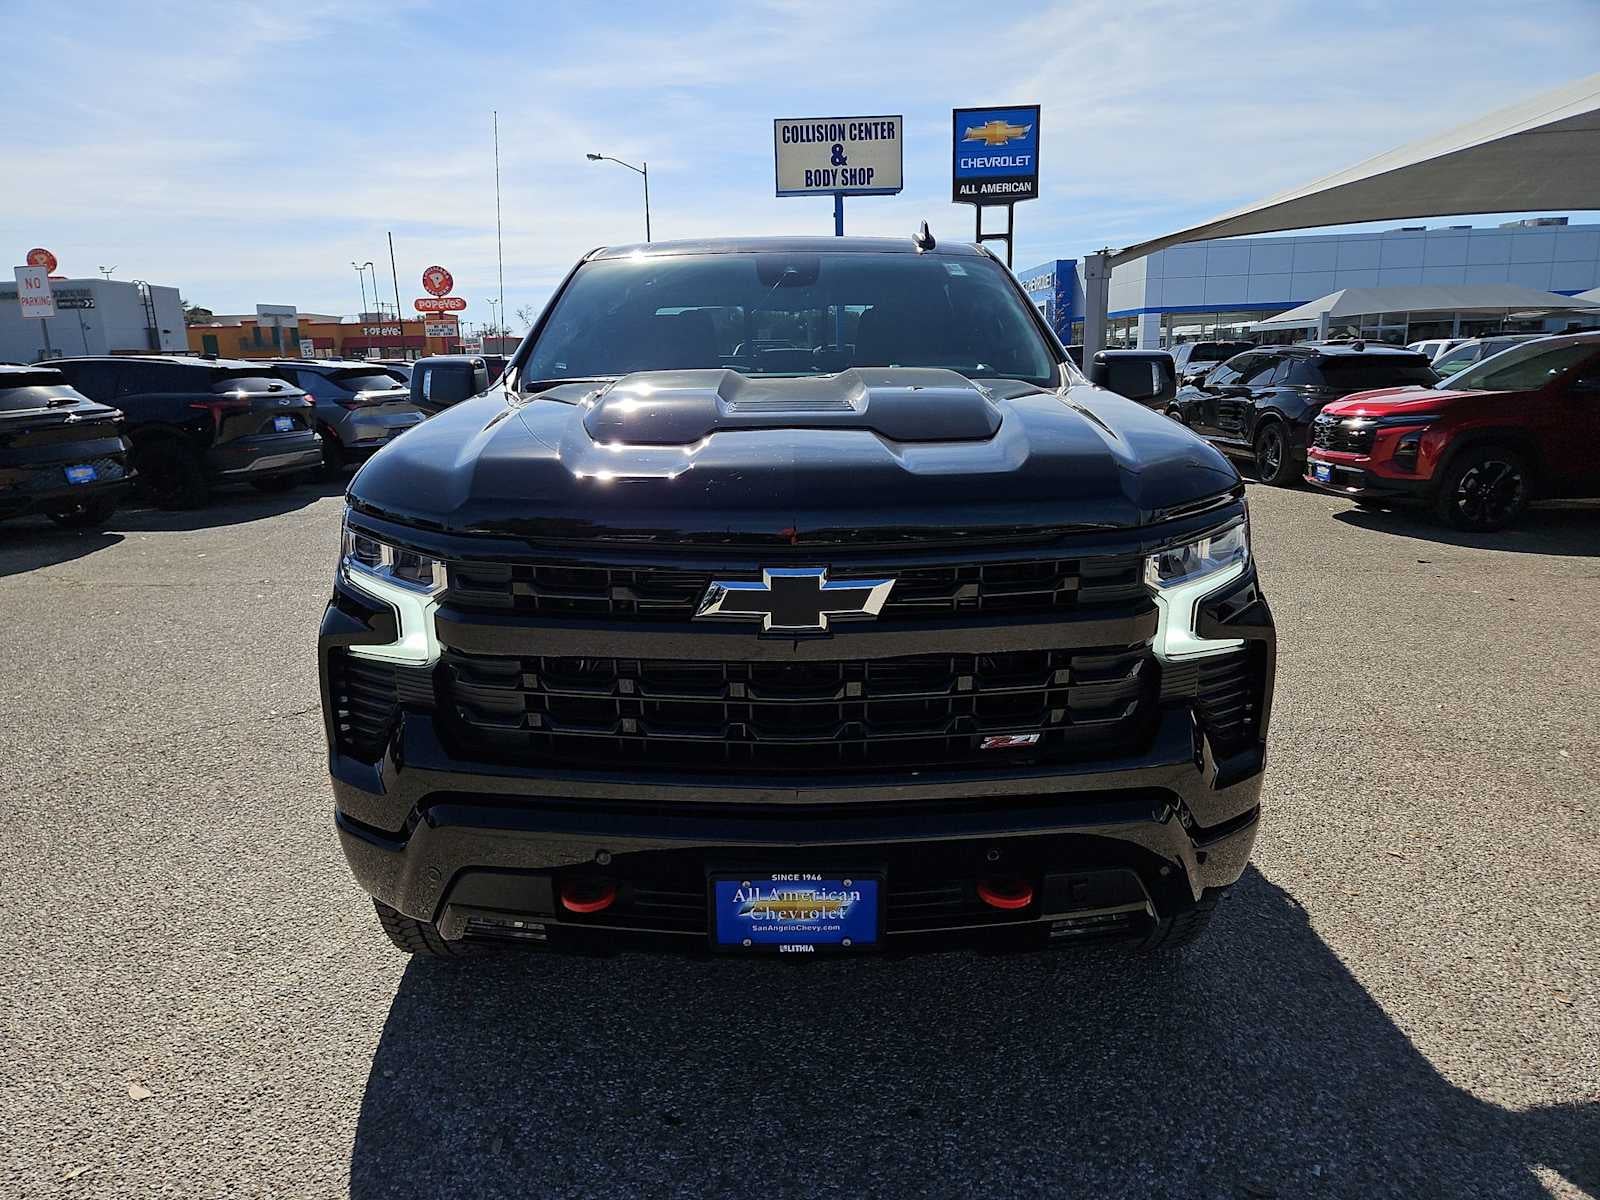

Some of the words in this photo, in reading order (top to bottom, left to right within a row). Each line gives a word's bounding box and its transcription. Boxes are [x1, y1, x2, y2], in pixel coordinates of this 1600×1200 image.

[782, 123, 846, 144] COLLISION
[849, 121, 895, 141] CENTER
[830, 143, 848, 166] &
[960, 155, 1031, 169] CHEVROLET
[805, 169, 838, 187] BODY
[840, 167, 874, 186] SHOP
[960, 184, 978, 194] ALL
[980, 182, 1032, 194] AMERICAN
[25, 277, 41, 289] NO
[21, 295, 51, 307] PARKING
[732, 887, 761, 903] All
[769, 887, 861, 902] American
[750, 907, 847, 921] Chevrolet
